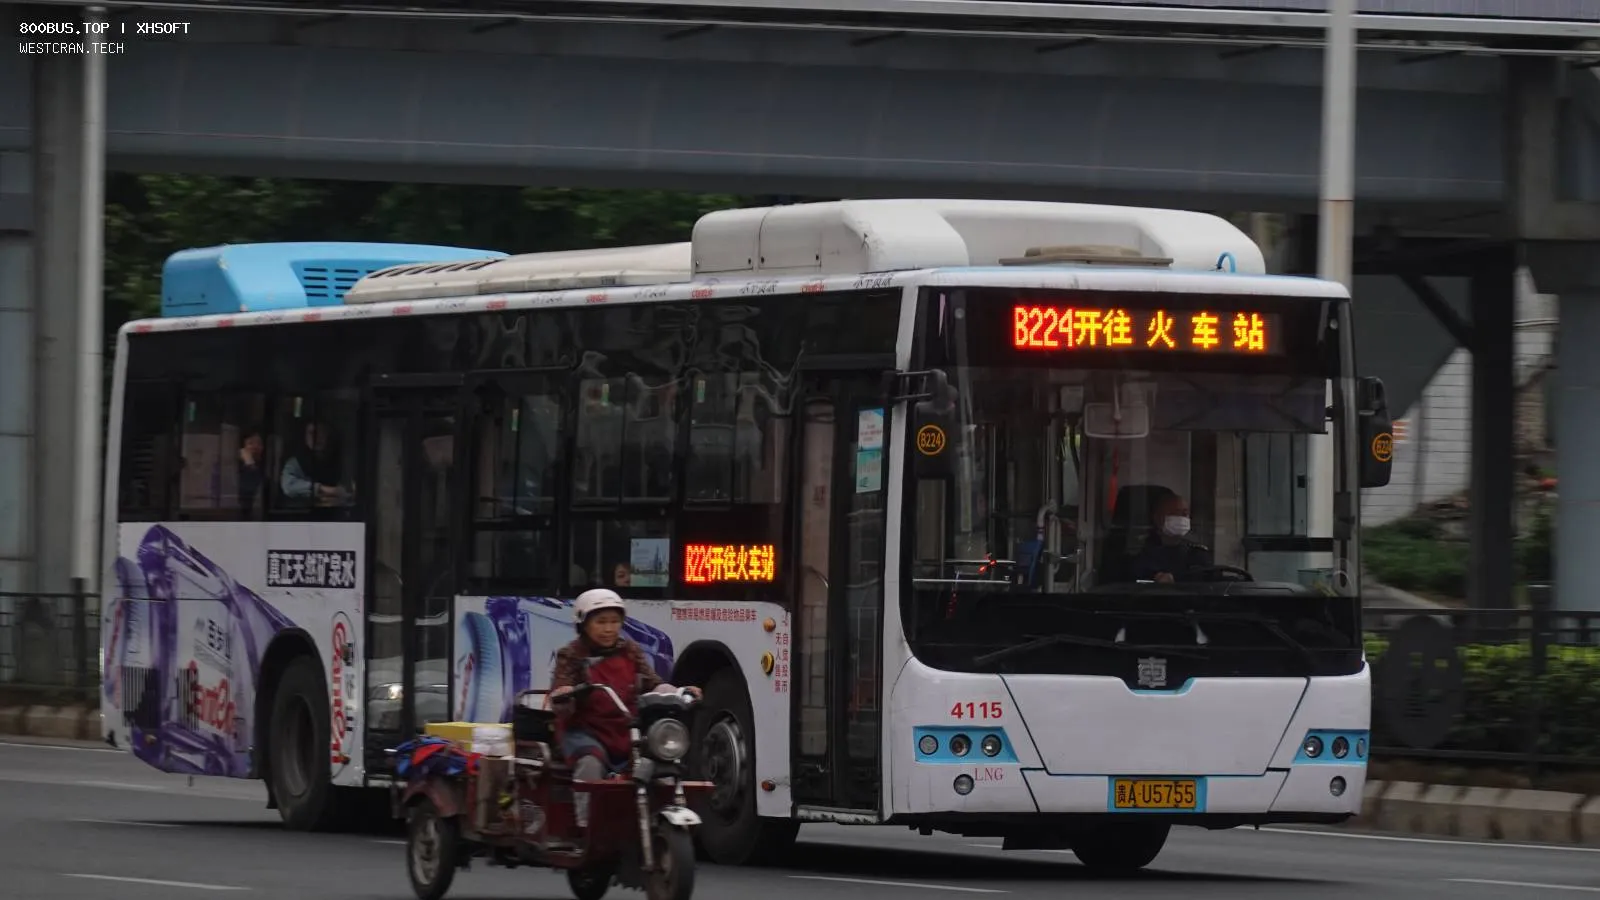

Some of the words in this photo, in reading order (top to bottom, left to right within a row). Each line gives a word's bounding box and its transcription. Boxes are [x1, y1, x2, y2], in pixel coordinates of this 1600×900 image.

[920, 432, 941, 448] B224
[268, 552, 354, 585] 真正天然矿泉水
[686, 545, 774, 582] B224开往火车站
[951, 702, 1003, 719] 4115
[974, 767, 1004, 781] LNG
